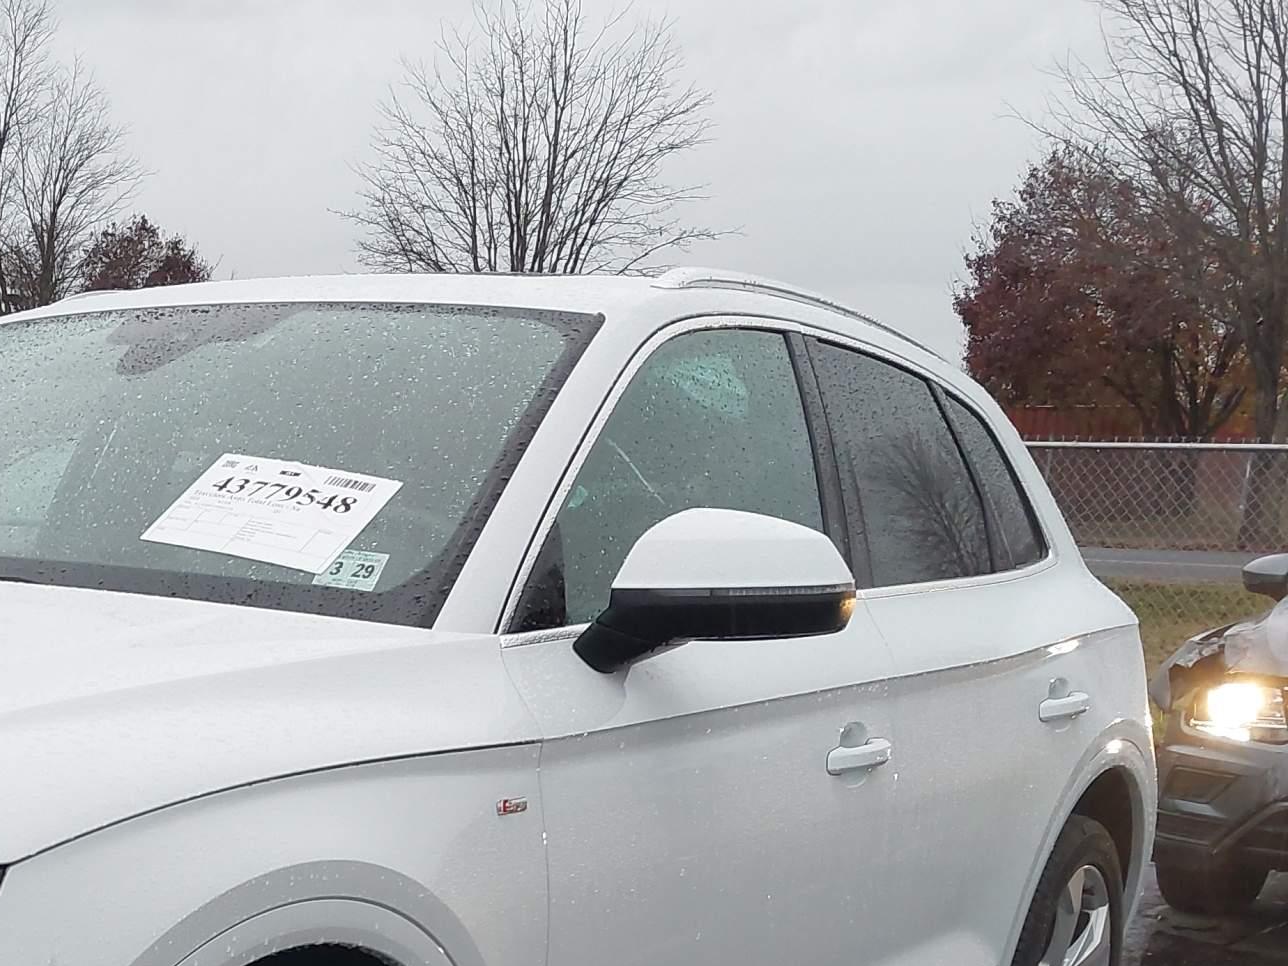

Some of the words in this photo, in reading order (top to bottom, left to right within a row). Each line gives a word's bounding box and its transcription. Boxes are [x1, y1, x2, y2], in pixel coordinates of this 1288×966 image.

[212, 476, 358, 513] 43779548
[329, 561, 343, 576] 3
[350, 563, 375, 579] 29
